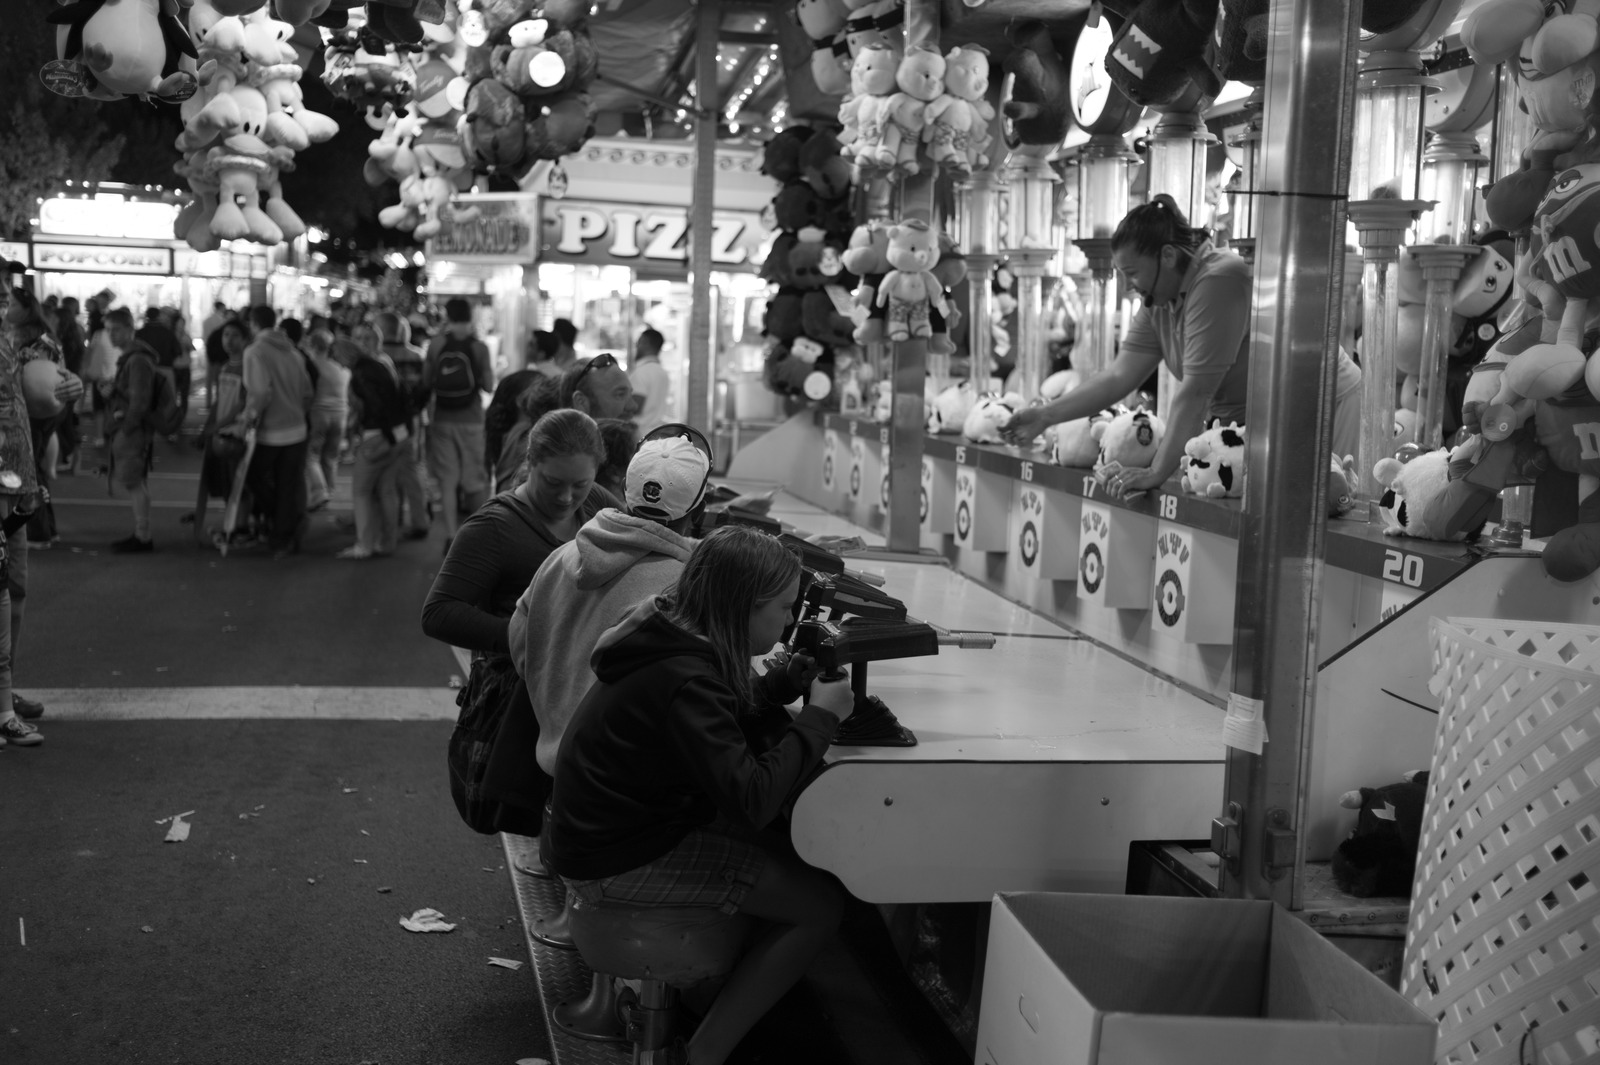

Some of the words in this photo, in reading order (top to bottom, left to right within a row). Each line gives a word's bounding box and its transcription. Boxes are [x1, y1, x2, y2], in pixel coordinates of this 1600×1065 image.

[1020, 460, 1034, 482] 16
[1083, 476, 1097, 498] 17
[1159, 494, 1178, 520] 18
[1382, 549, 1424, 587] 20
